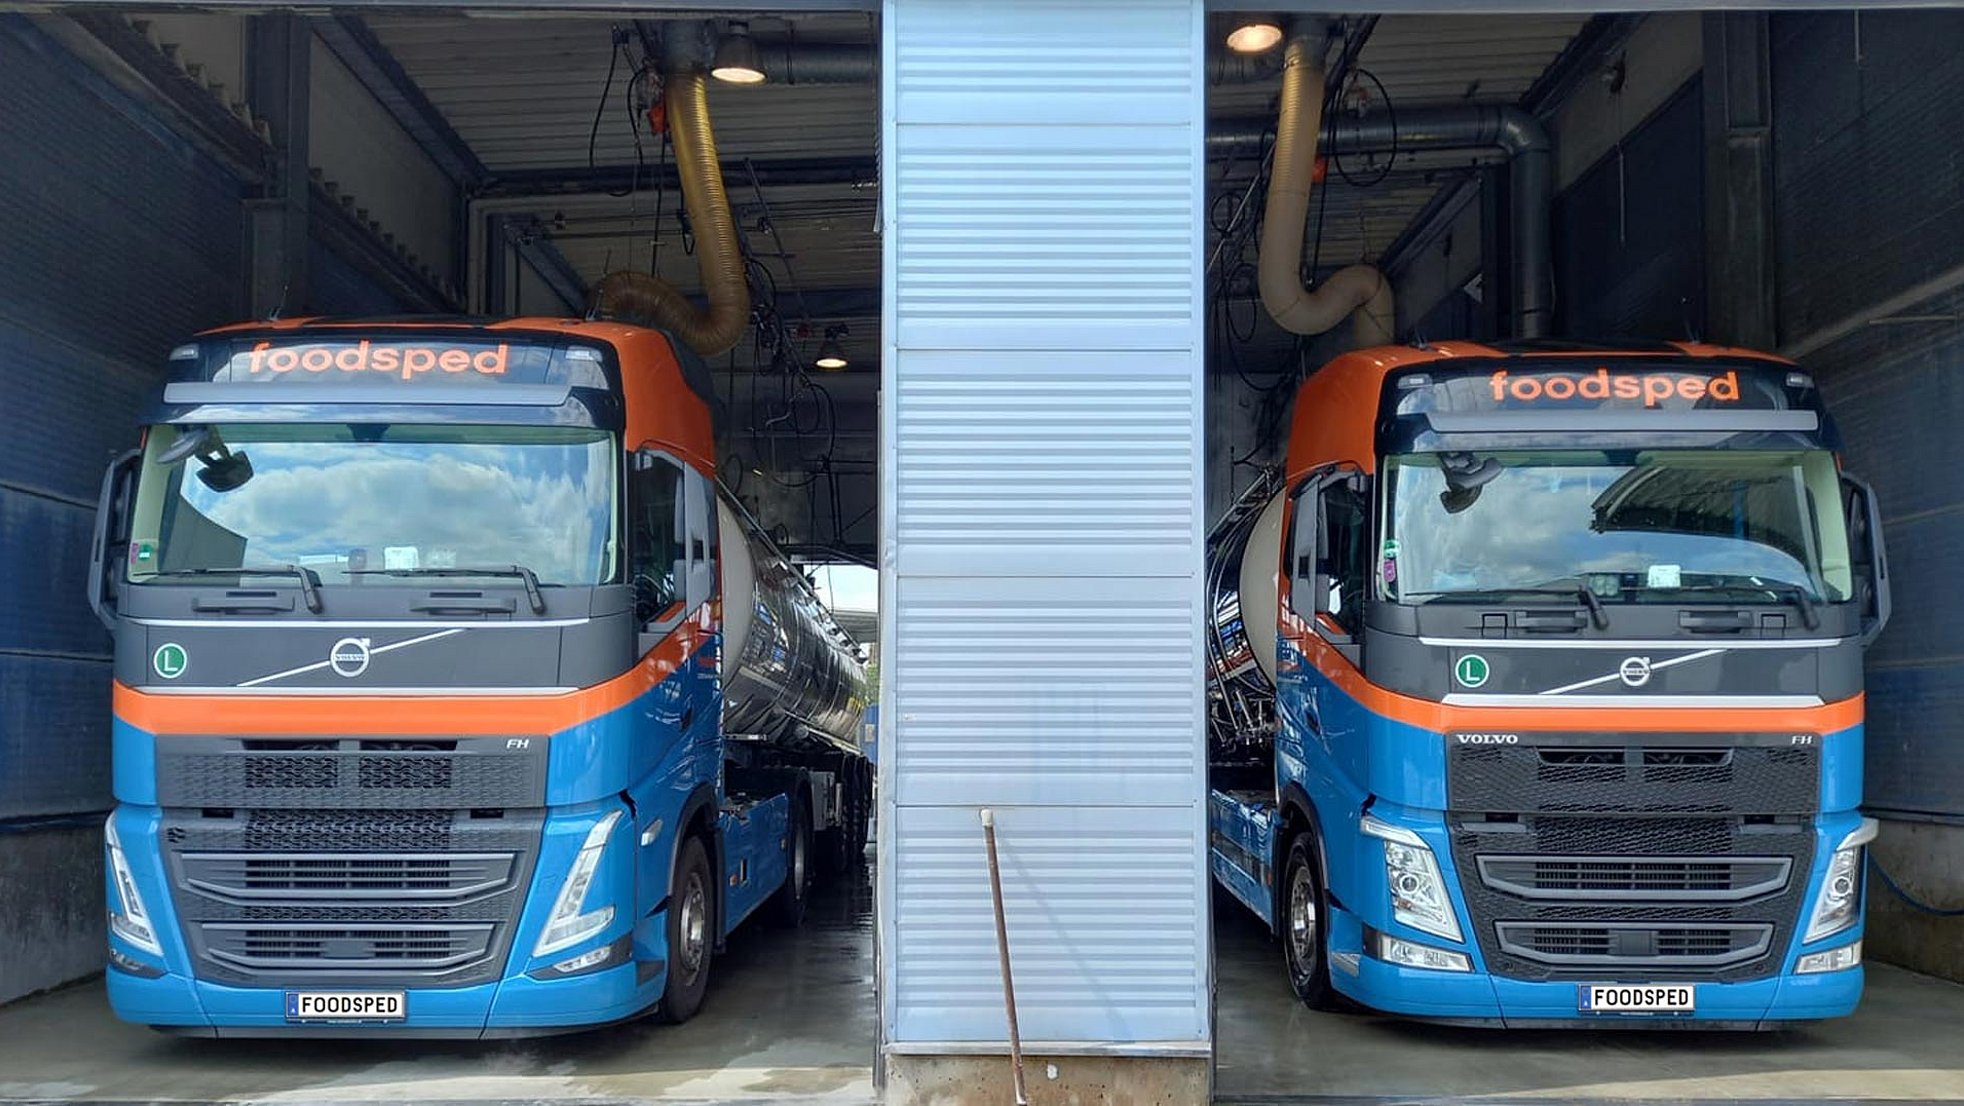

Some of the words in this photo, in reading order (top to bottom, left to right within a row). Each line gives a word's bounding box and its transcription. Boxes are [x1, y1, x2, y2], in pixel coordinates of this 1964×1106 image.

[249, 340, 509, 380] foodsped
[1489, 368, 1740, 406] foodsped
[164, 650, 179, 672] L
[1465, 660, 1481, 681] L
[506, 738, 530, 749] FH
[1456, 734, 1519, 745] VOLVO
[1791, 735, 1813, 745] FH
[302, 996, 398, 1014] FOODSPED
[1594, 989, 1689, 1006] FOODSPED
